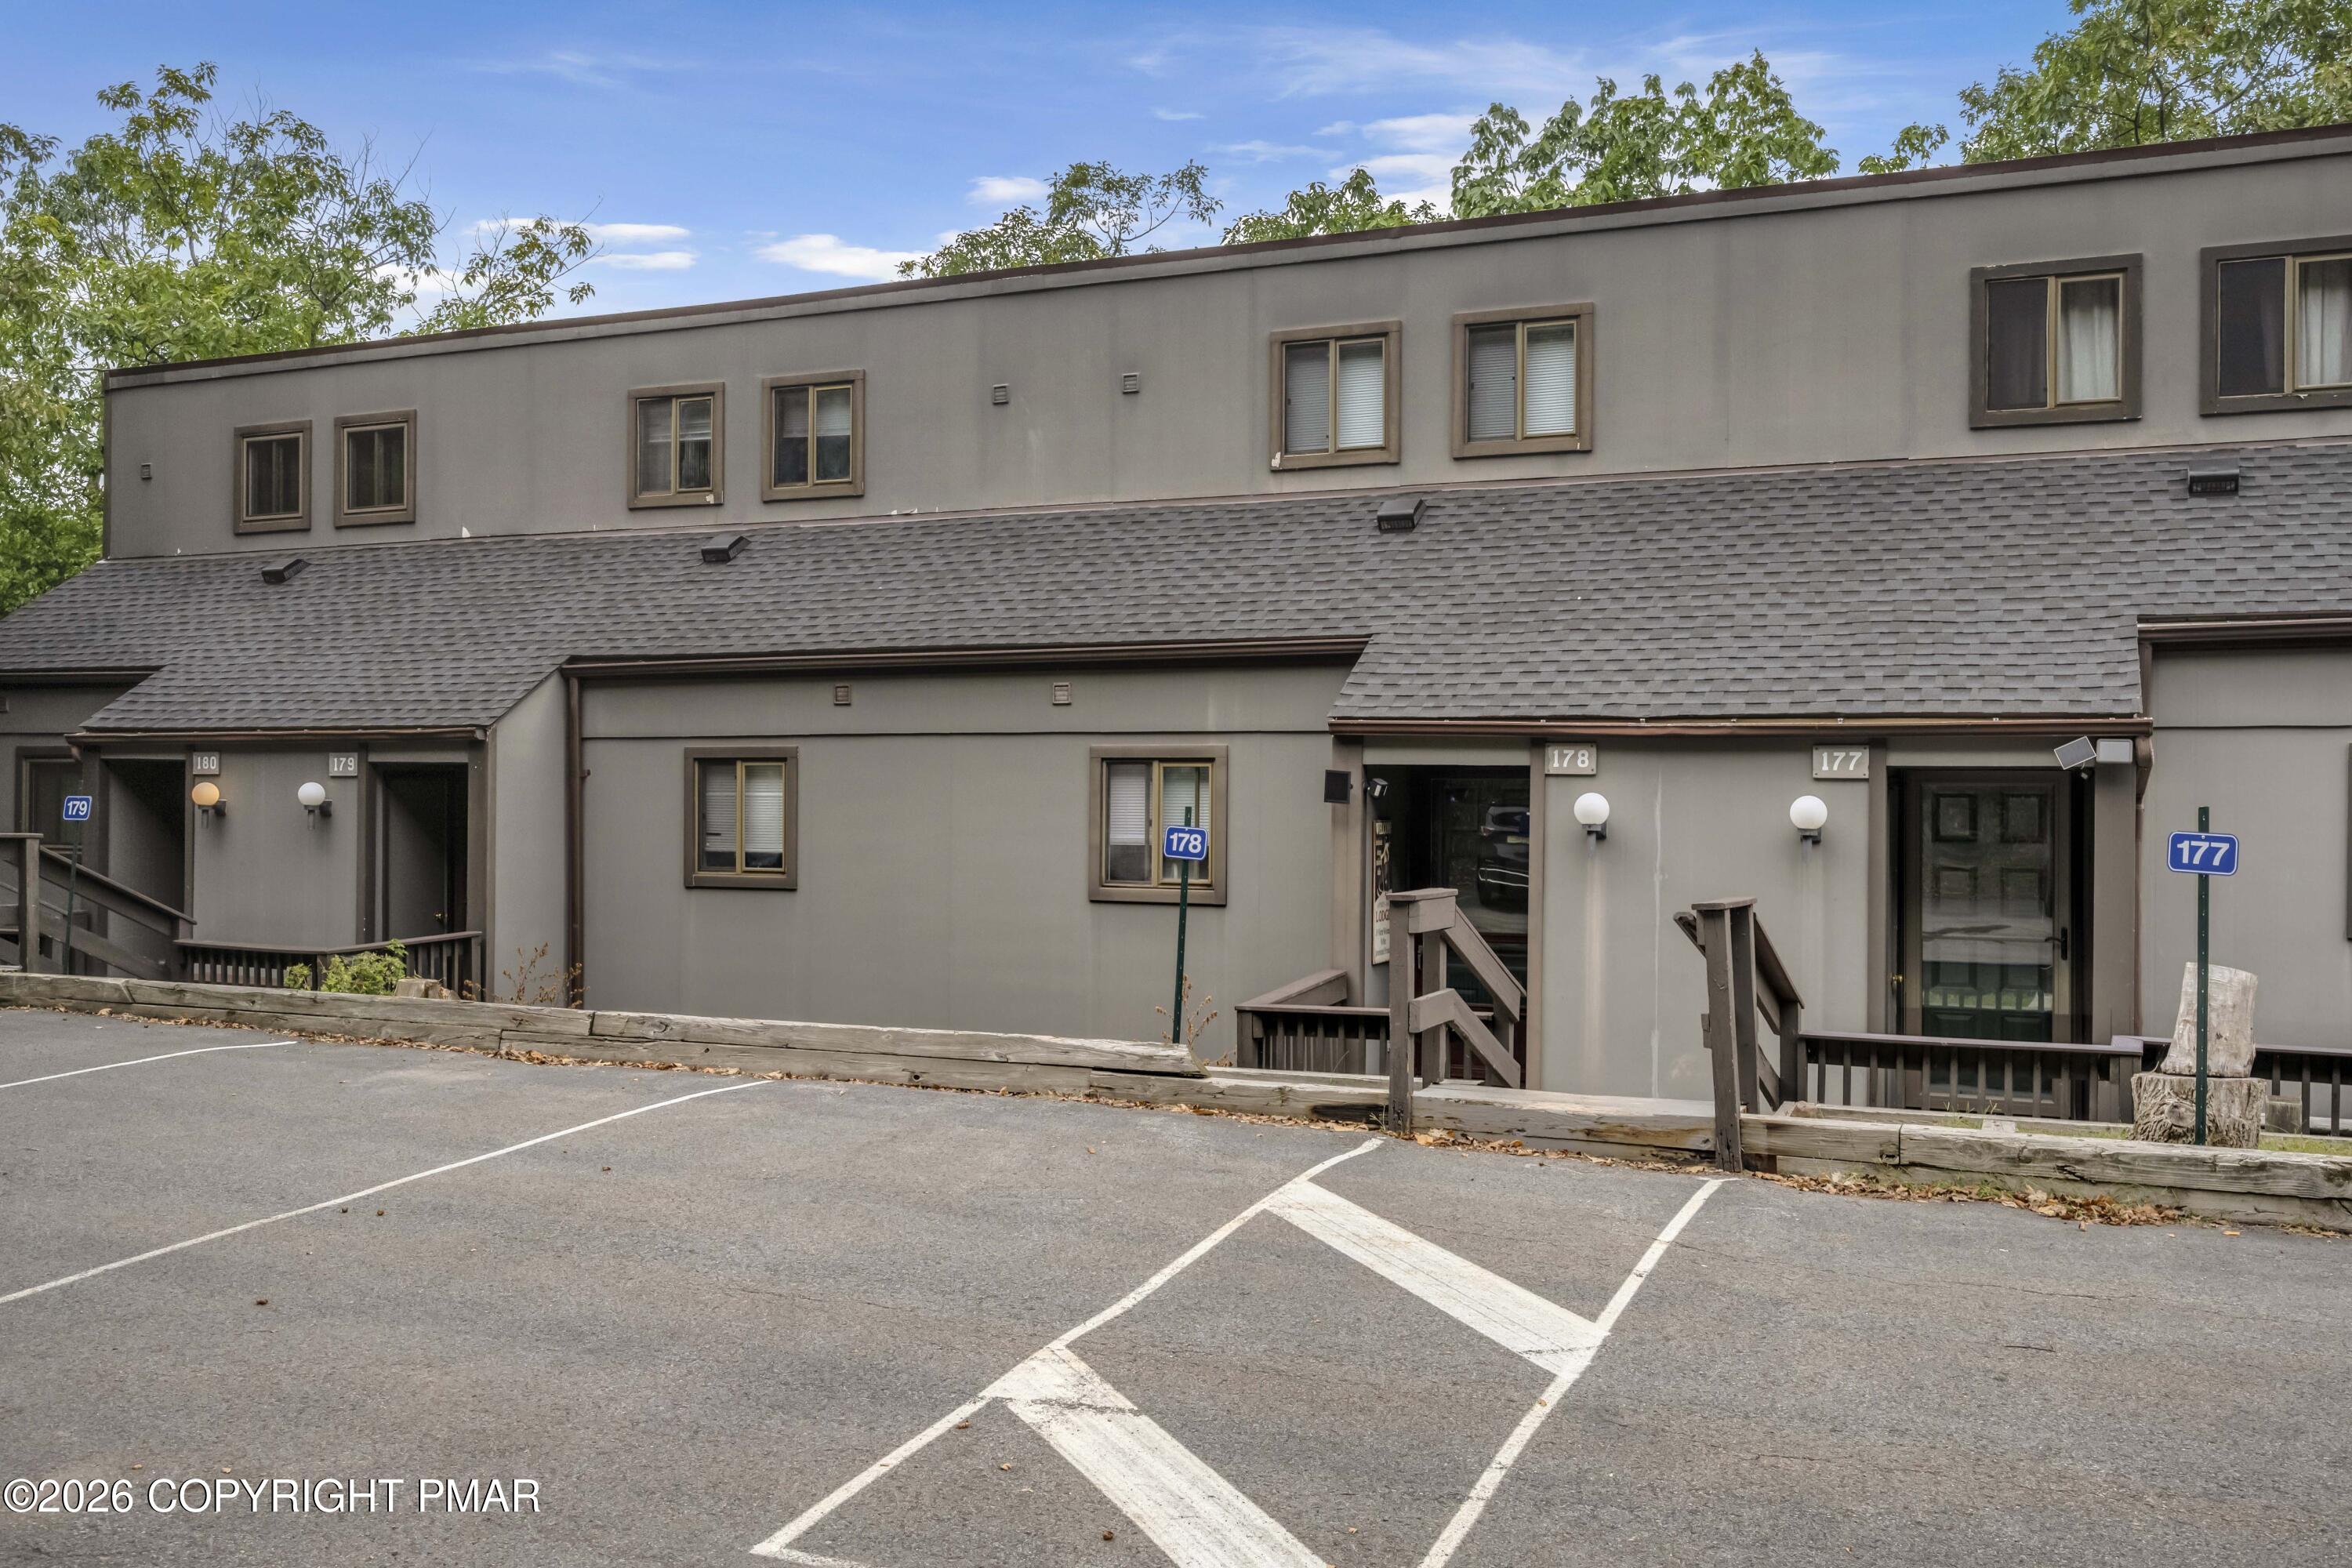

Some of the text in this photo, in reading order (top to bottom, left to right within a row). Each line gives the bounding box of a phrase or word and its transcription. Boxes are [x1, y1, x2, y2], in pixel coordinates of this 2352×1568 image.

[198, 756, 216, 770] 180
[333, 757, 354, 771] 179
[1552, 749, 1589, 768] 178
[1821, 752, 1863, 771] 177
[67, 800, 88, 815] 179
[1170, 833, 1202, 854] 178
[2176, 840, 2230, 866] 177
